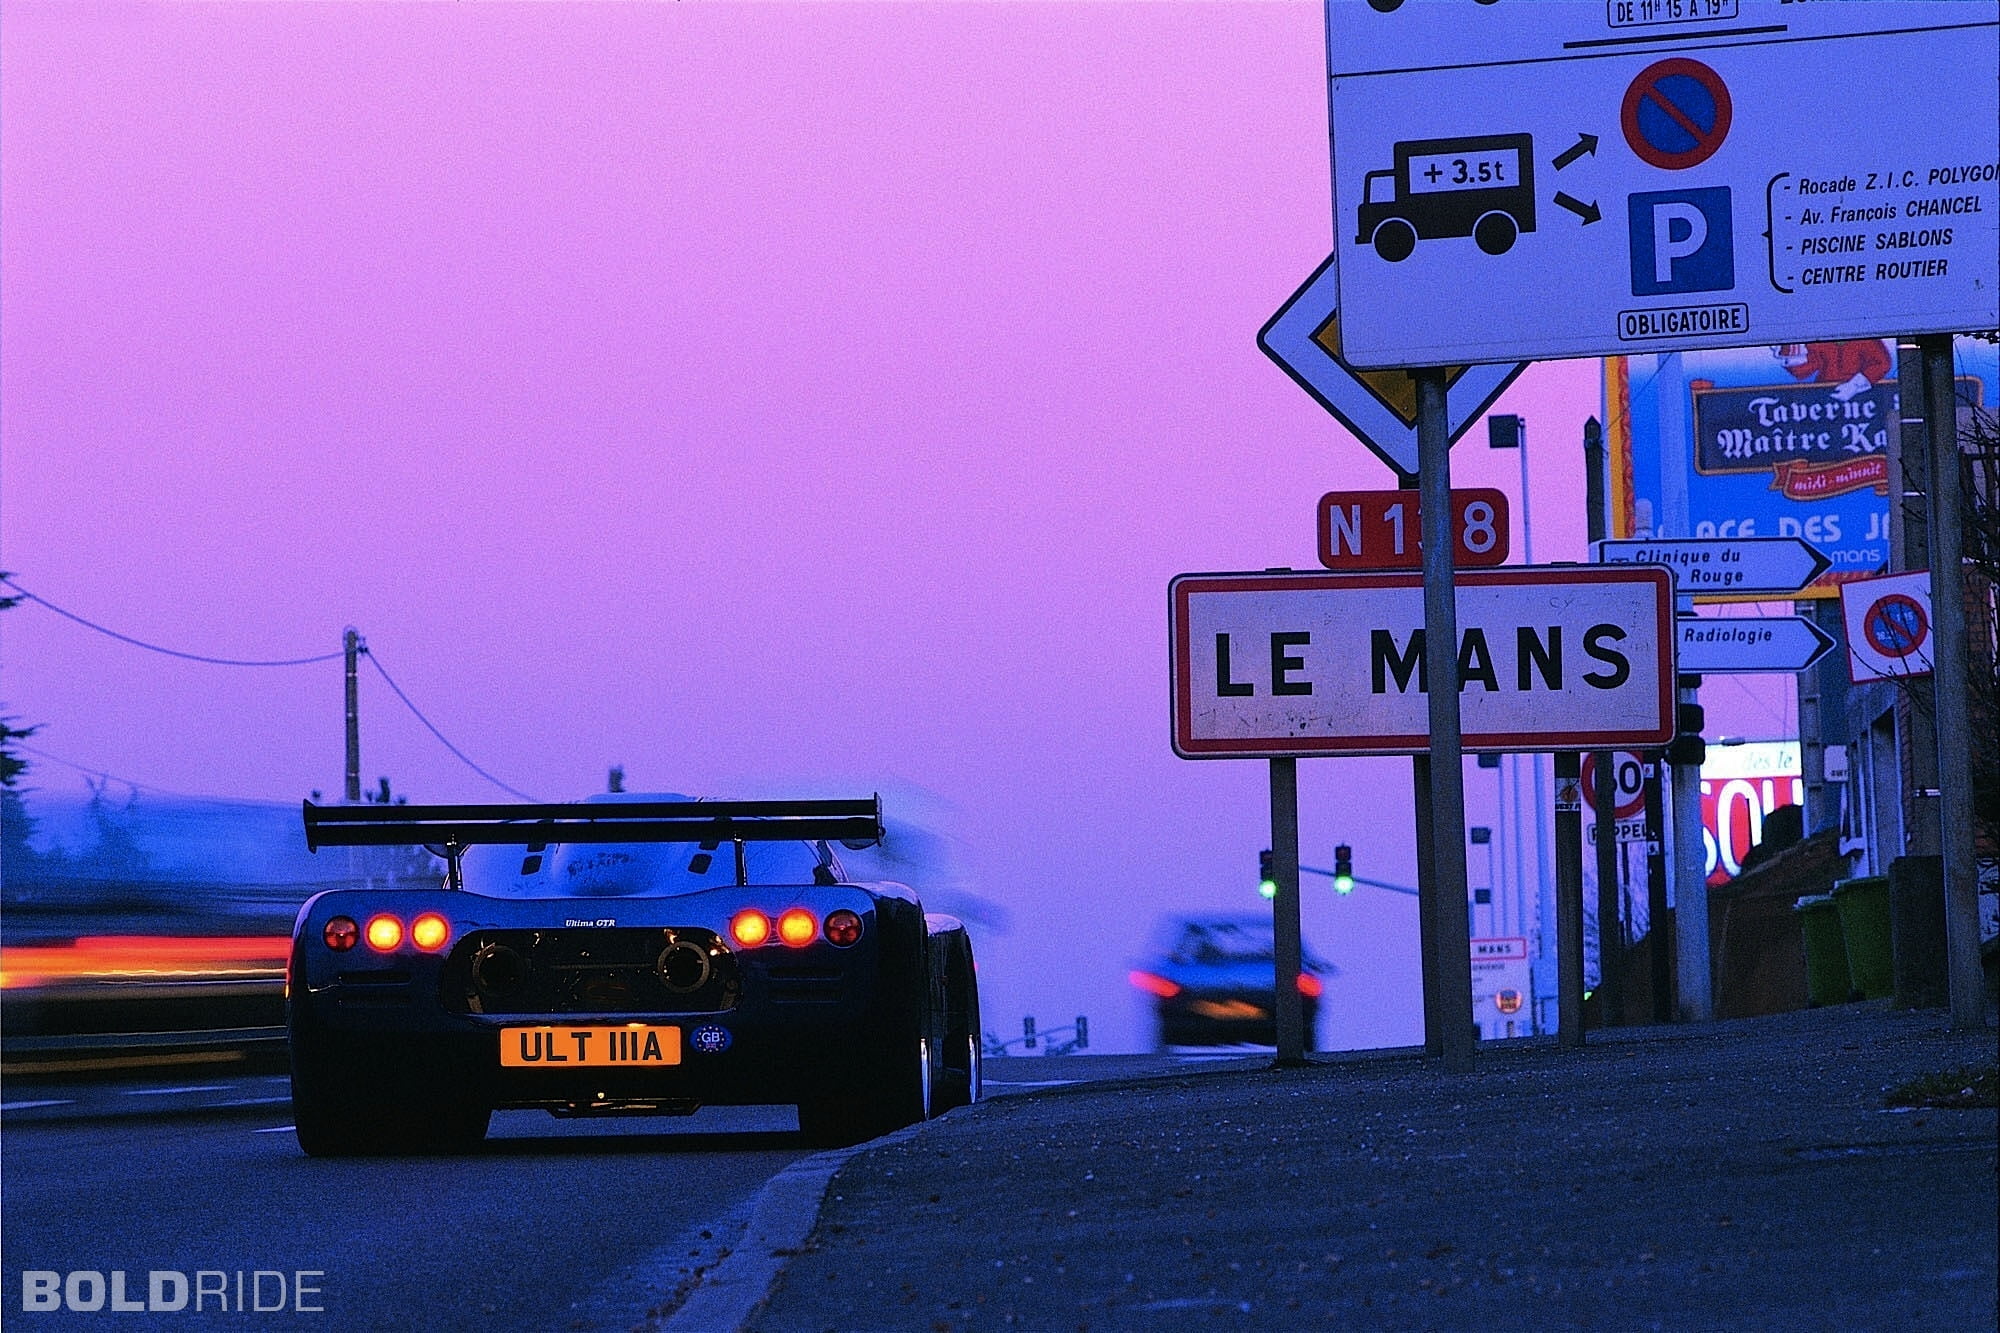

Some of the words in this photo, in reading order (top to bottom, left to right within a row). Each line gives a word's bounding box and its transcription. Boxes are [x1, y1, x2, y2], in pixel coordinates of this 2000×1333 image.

[1617, 2, 1634, 22] DE
[1666, 0, 1682, 18] 15
[1690, 0, 1698, 16] A
[1799, 176, 1857, 195] Rocade
[1866, 170, 1919, 190] Z.I.C.
[1800, 208, 1824, 225] Av.
[1831, 203, 1897, 223] François
[1906, 196, 1983, 217] CHANCEL
[1801, 234, 1866, 255] PISCINE
[1875, 228, 1953, 250] SABLONS
[1802, 265, 1866, 285] CENTRE
[1876, 259, 1948, 280] ROUTIER
[1626, 308, 1741, 336] OBLIGATOIRE
[1749, 396, 1877, 427] Taverne
[1717, 427, 1831, 459] Maître
[1330, 504, 1362, 556] N
[1384, 500, 1497, 555] 18
[1779, 514, 1842, 543] DES
[1635, 549, 1711, 566] Clinique
[1721, 549, 1740, 562] du
[1830, 548, 1881, 563] mans
[1690, 569, 1744, 585] Rouge
[1684, 628, 1773, 645] Radiologie
[1215, 632, 1313, 697] LE
[1370, 623, 1631, 695] MANS
[565, 919, 594, 927] Ultima
[596, 919, 616, 927] GTR
[520, 1032, 592, 1062] ULT
[701, 1031, 721, 1044] GB
